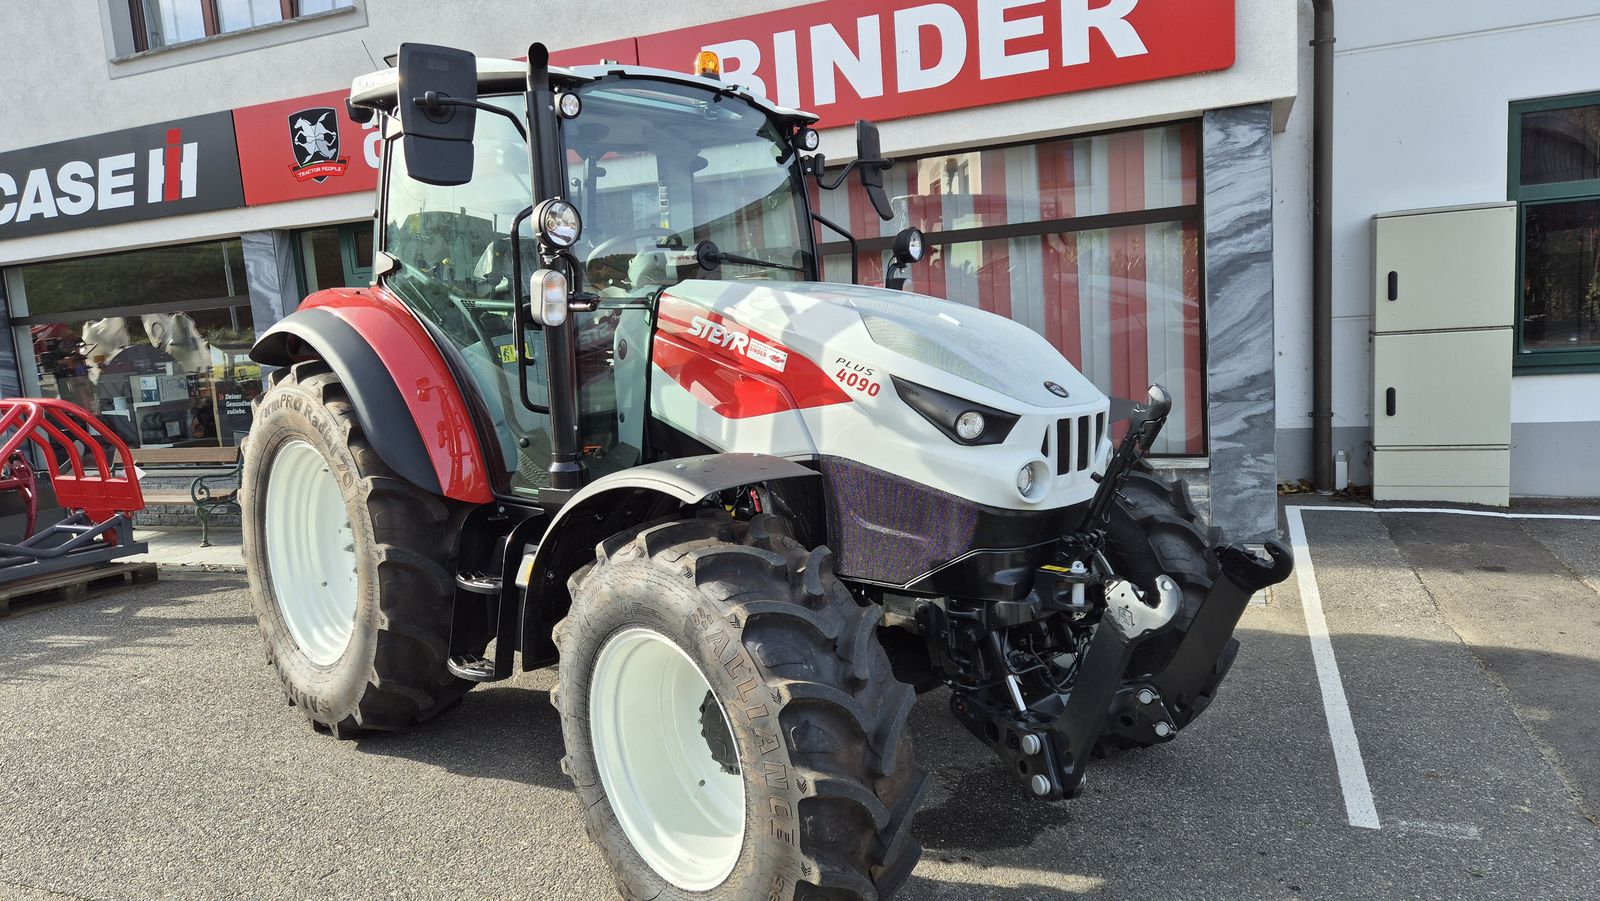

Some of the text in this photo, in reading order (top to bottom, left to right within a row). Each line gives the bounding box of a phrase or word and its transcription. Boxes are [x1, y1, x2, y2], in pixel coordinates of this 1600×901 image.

[701, 0, 1149, 108] BINDER
[298, 166, 321, 177] TRACTOR
[686, 316, 746, 356] STEYR
[836, 357, 876, 376] PLUS
[836, 368, 881, 397] 4090
[704, 629, 795, 847] ALLIANCE
